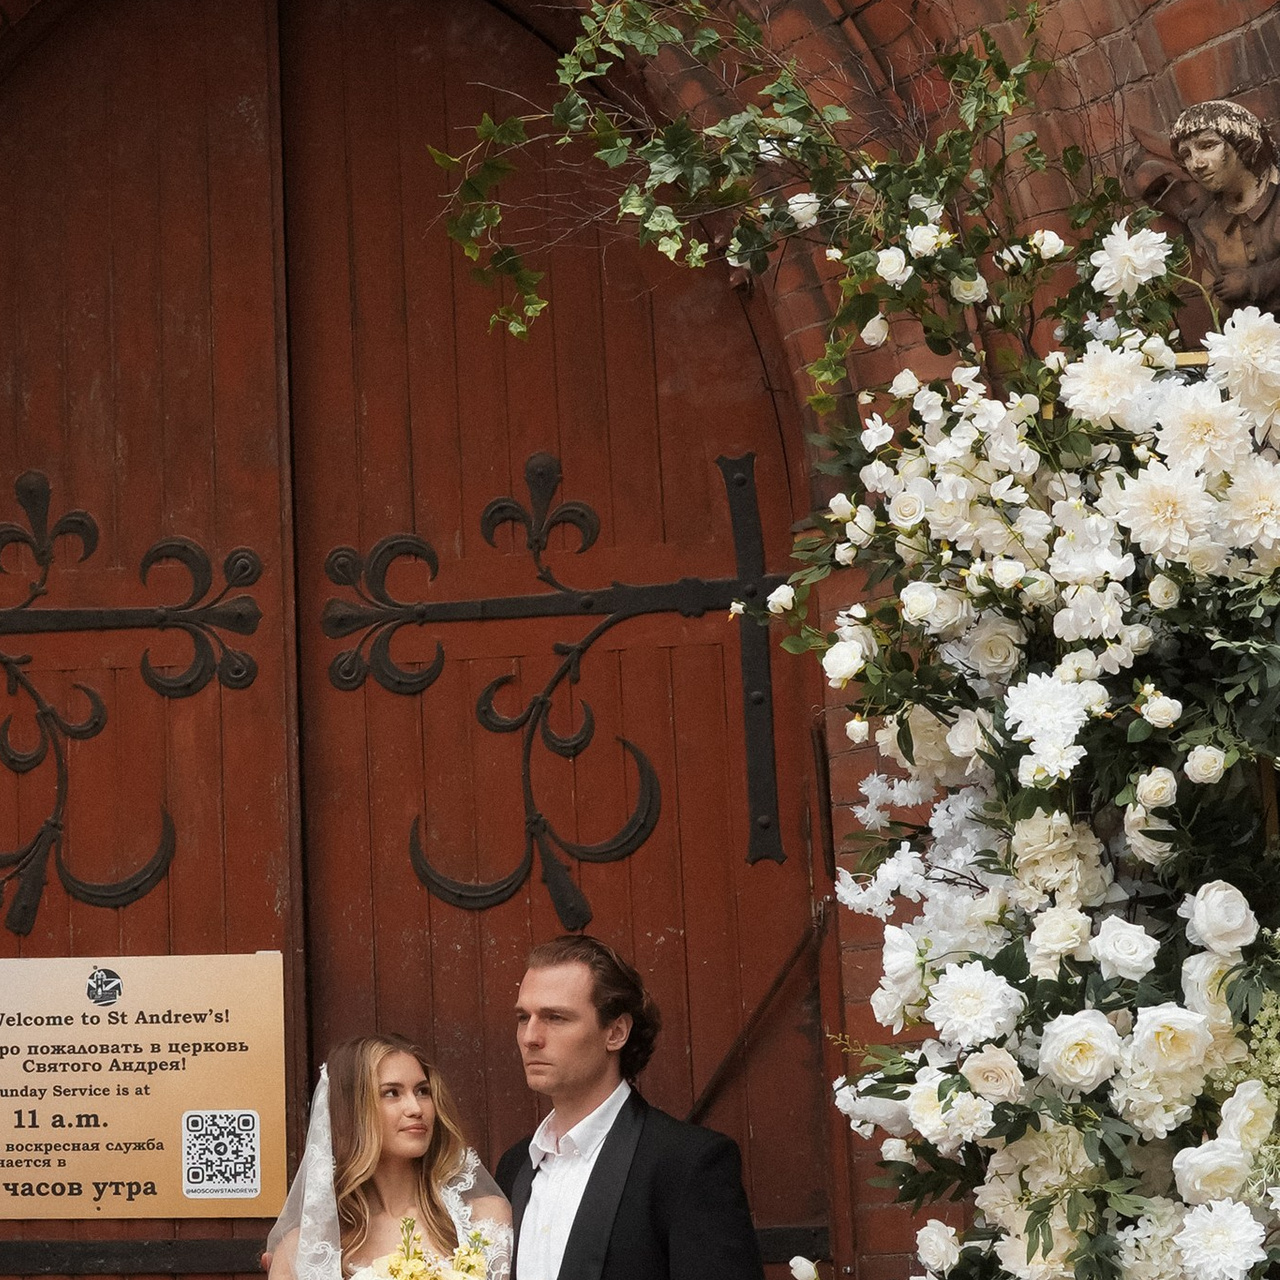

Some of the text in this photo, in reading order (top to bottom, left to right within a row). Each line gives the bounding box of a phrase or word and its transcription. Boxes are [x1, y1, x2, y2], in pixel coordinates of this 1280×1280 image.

[81, 1012, 100, 1025] to
[108, 1011, 128, 1025] St
[135, 1009, 229, 1024] Andrew’s!
[27, 1043, 143, 1056] пожаловать
[150, 1043, 161, 1053] в
[168, 1042, 248, 1056] церковь
[23, 1057, 186, 1075] Святого Андрея!
[53, 1084, 110, 1097] Service
[116, 1084, 129, 1096] is
[135, 1085, 150, 1095] at
[14, 1109, 108, 1128] 11 a.m.
[6, 1143, 100, 1155] воскресная
[105, 1138, 164, 1154] служба
[57, 1159, 66, 1167] в
[2, 1182, 82, 1196] часов
[92, 1181, 157, 1202] утра
